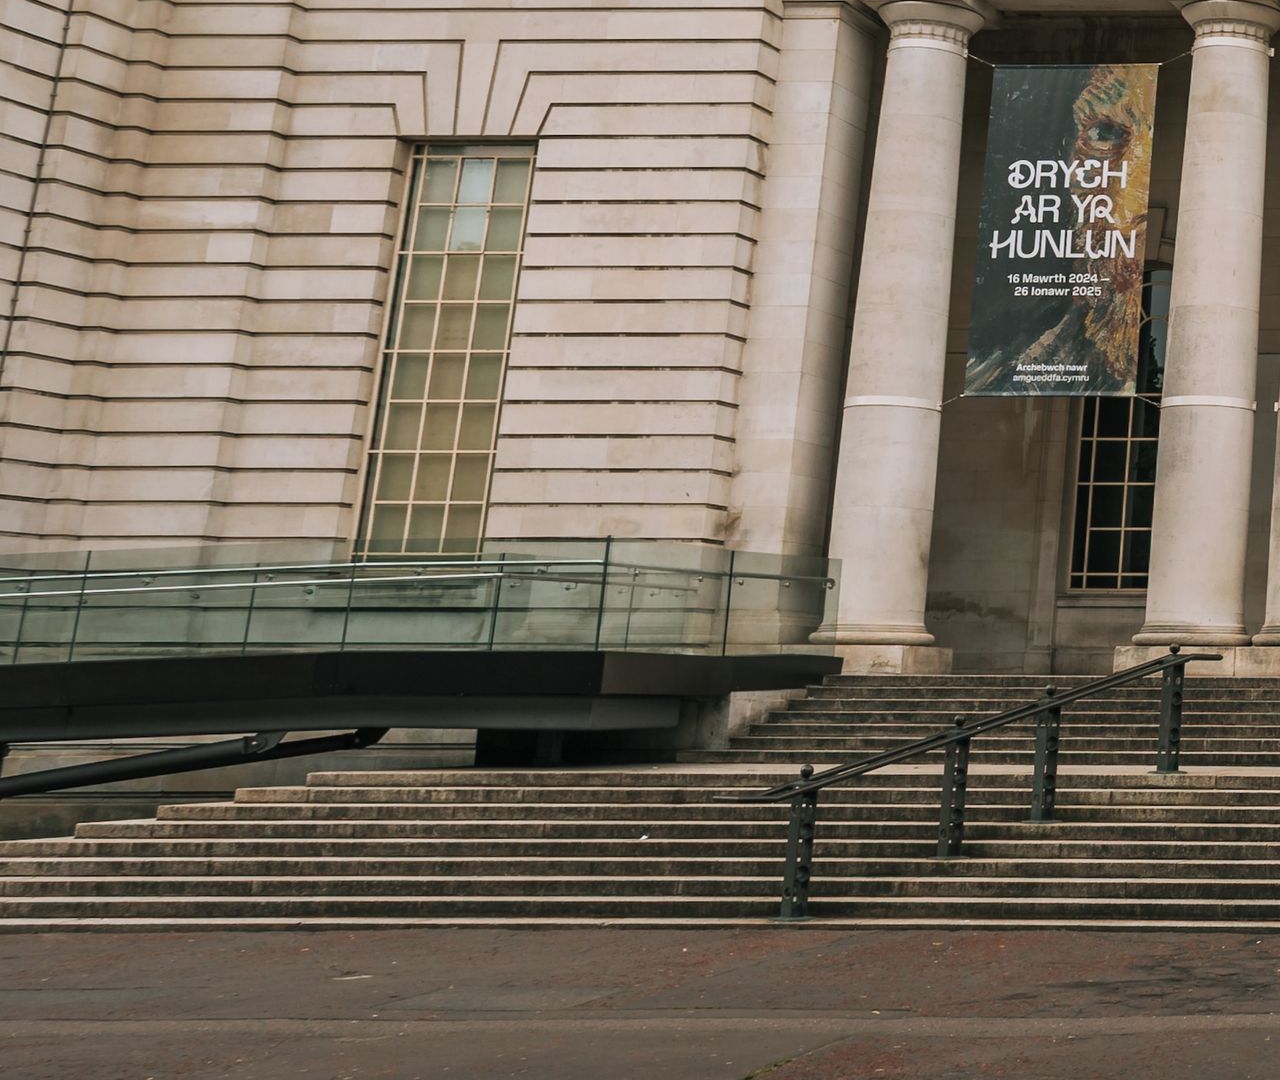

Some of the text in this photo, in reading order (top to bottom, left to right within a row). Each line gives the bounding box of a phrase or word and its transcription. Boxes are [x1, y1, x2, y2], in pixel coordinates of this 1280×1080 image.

[1007, 159, 1128, 189] DRYCH
[1011, 194, 1116, 224] AR YR
[988, 229, 1137, 260] HUNLUN
[1007, 273, 1020, 284] 16
[1022, 273, 1066, 284] Mawrth
[1068, 273, 1099, 284] 2024
[1014, 286, 1102, 296] 26 Ionawr 2025
